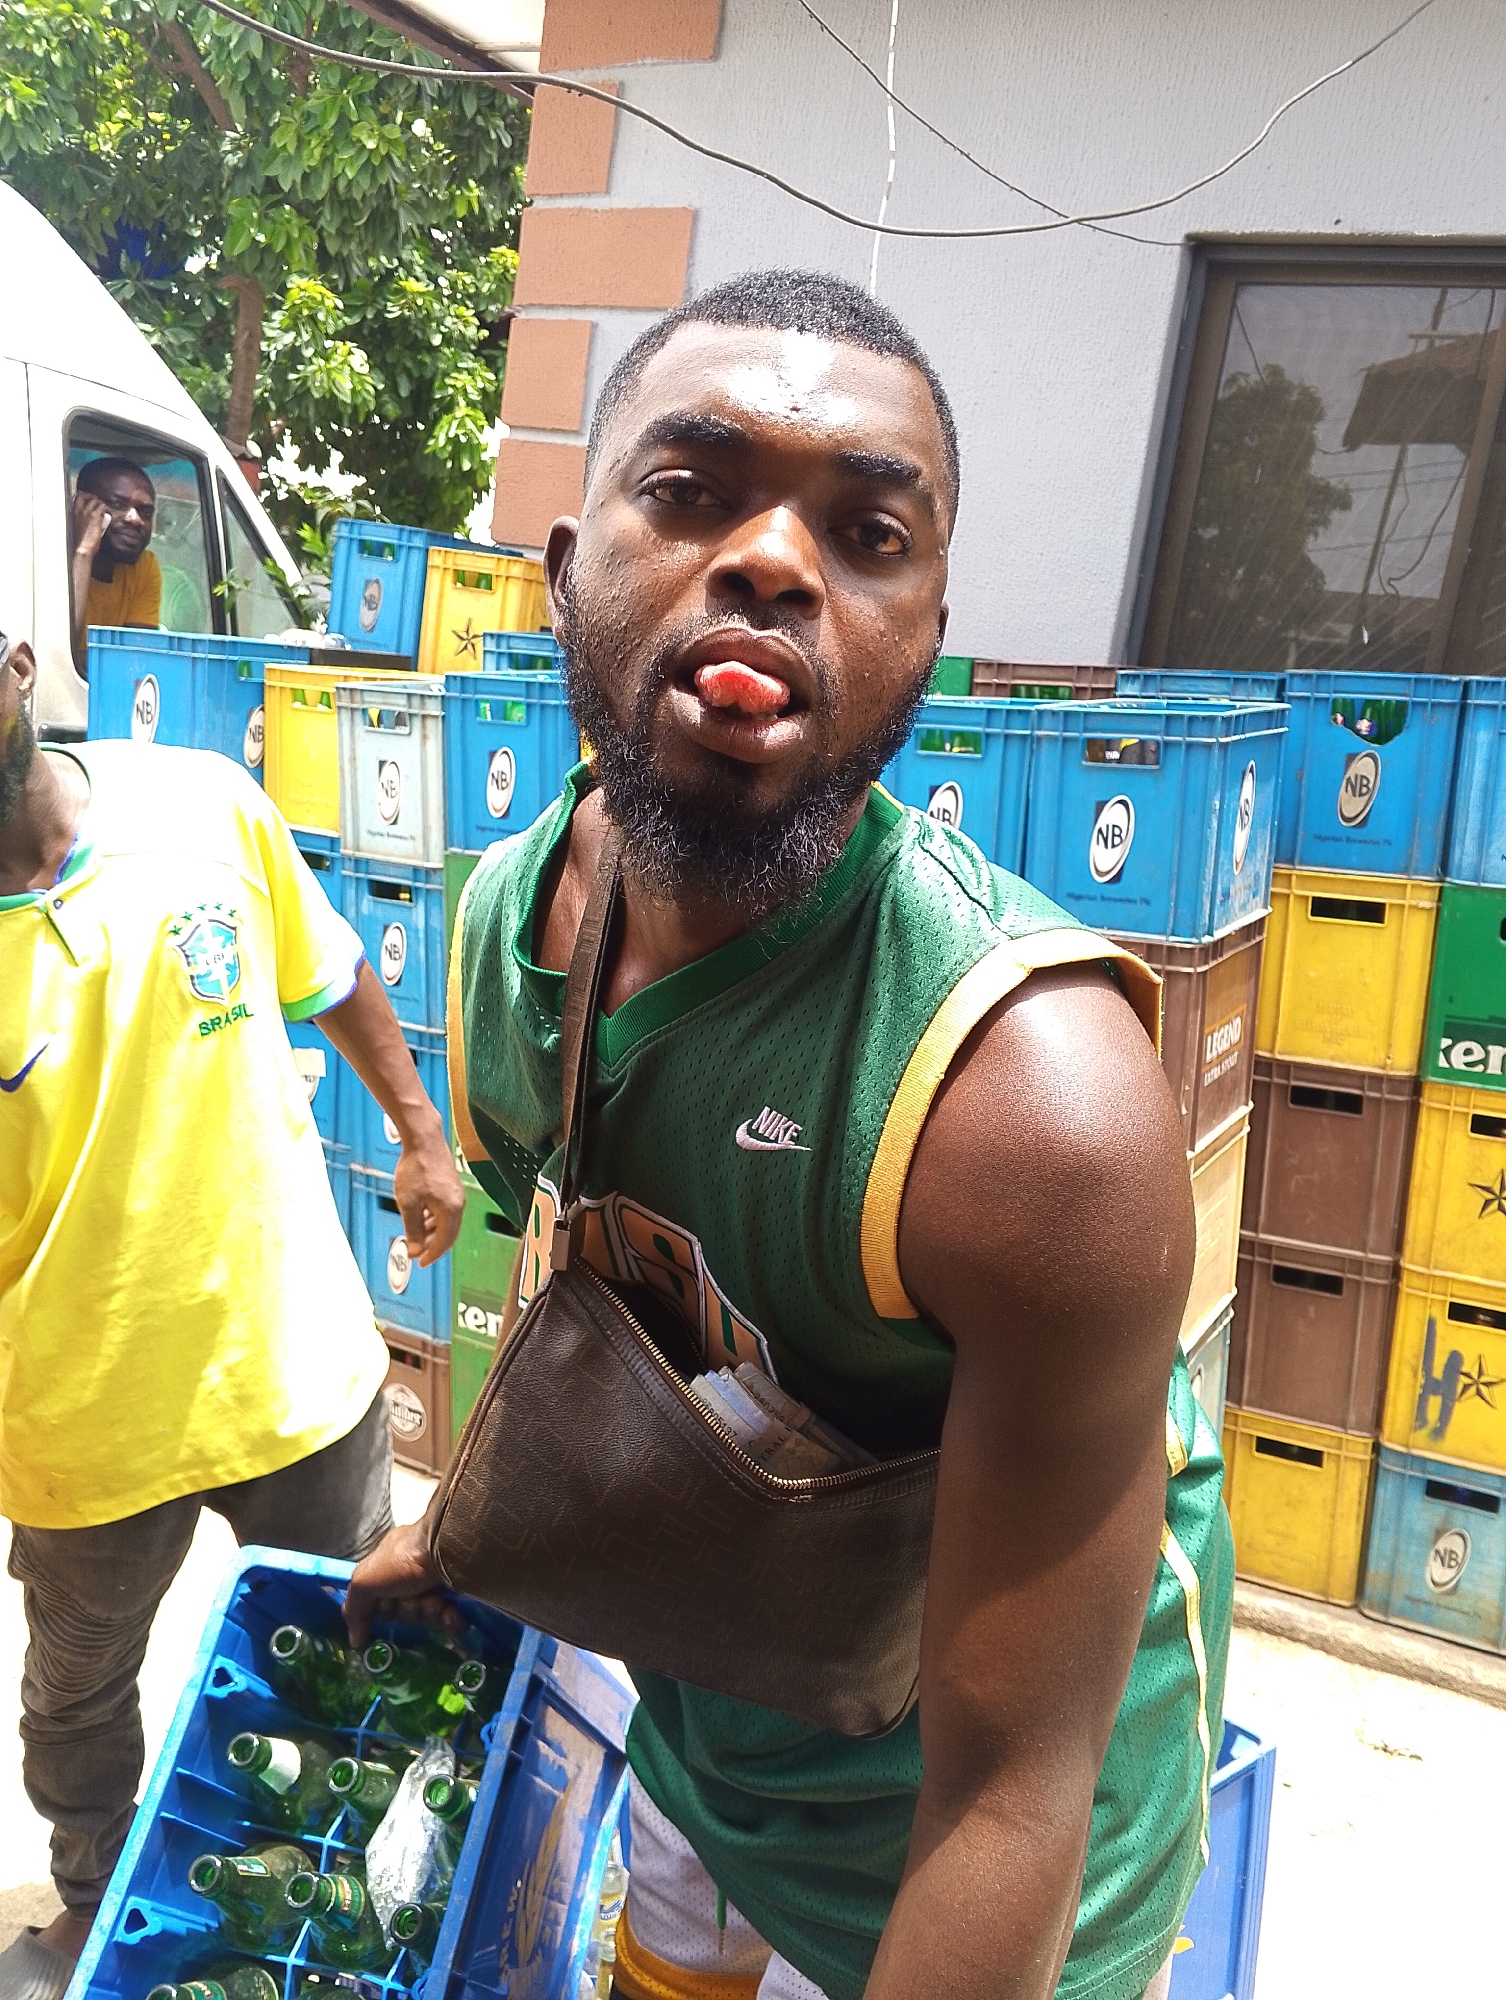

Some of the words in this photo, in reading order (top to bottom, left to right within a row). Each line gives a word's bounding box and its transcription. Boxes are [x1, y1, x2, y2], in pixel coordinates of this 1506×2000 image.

[135, 699, 154, 725] NB
[249, 723, 265, 743] NB
[381, 779, 399, 799] NB
[491, 770, 510, 791] NB
[1345, 773, 1372, 798] NB
[1238, 798, 1251, 832] NB
[1096, 823, 1124, 850] NB
[384, 943, 403, 961] NB
[198, 1003, 255, 1037] BRASIL
[1205, 1015, 1242, 1065] LEGEND
[751, 1105, 804, 1146] NIKE
[390, 1252, 408, 1273] NB
[1433, 1546, 1460, 1569] NB
